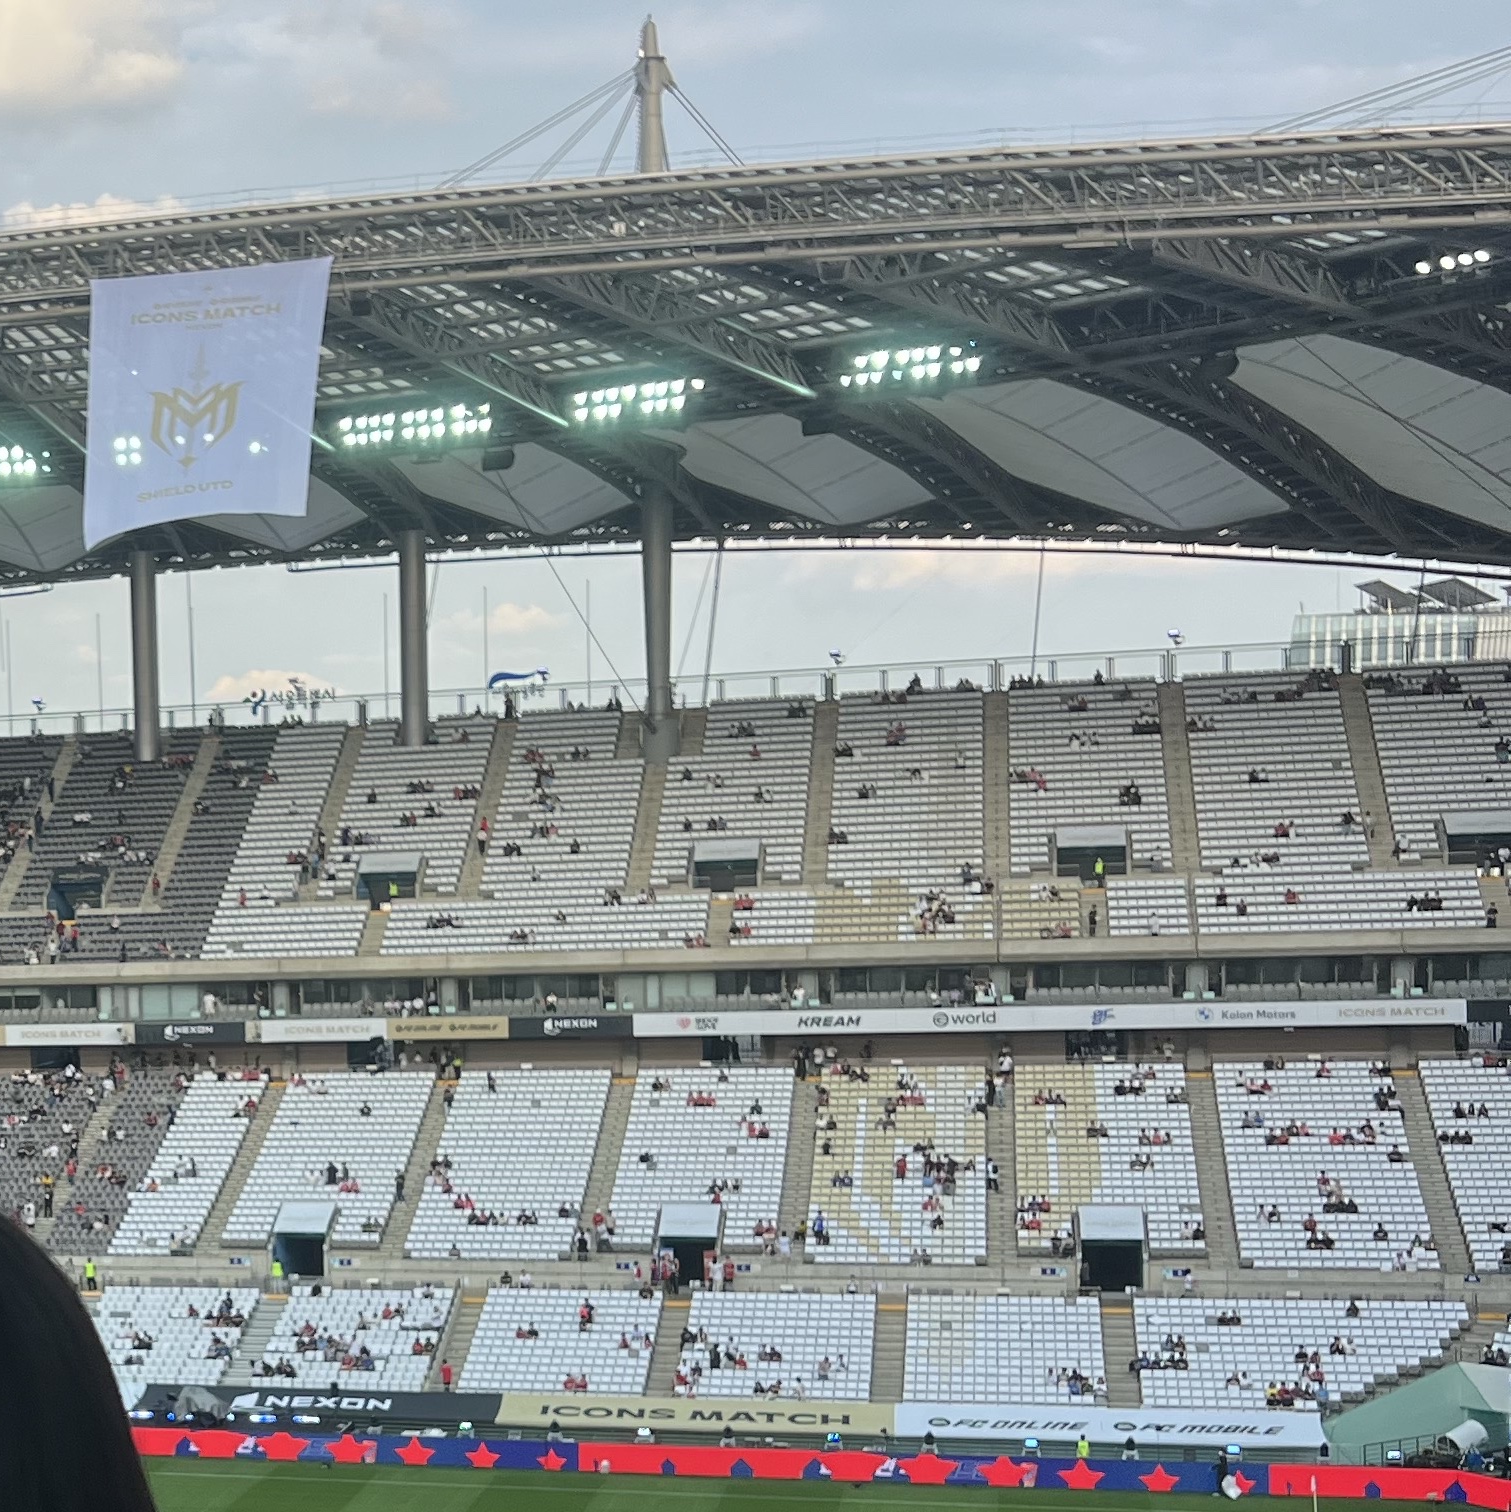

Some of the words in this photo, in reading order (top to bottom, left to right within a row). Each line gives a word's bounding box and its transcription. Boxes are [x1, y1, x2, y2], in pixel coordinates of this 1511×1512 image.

[130, 309, 199, 326] ICONS
[202, 302, 283, 320] MATCH
[950, 1010, 997, 1025] world
[1221, 1008, 1255, 1020] Kolon
[1256, 1009, 1296, 1020] Motors
[1338, 1007, 1386, 1018] ICONS
[1390, 1006, 1445, 1017] MATCH
[554, 1017, 598, 1029] NEXON
[797, 1015, 862, 1028] KREAM
[174, 1024, 214, 1035] NEXON
[325, 1025, 371, 1035] MATCH
[263, 1395, 392, 1412] NEXON
[539, 1404, 676, 1420] ICONS
[688, 1409, 851, 1426] MATCH
[950, 1418, 989, 1430] FC
[990, 1420, 1087, 1431] ONLINE
[1136, 1422, 1176, 1434] FC
[1175, 1424, 1285, 1436] MOBILE
